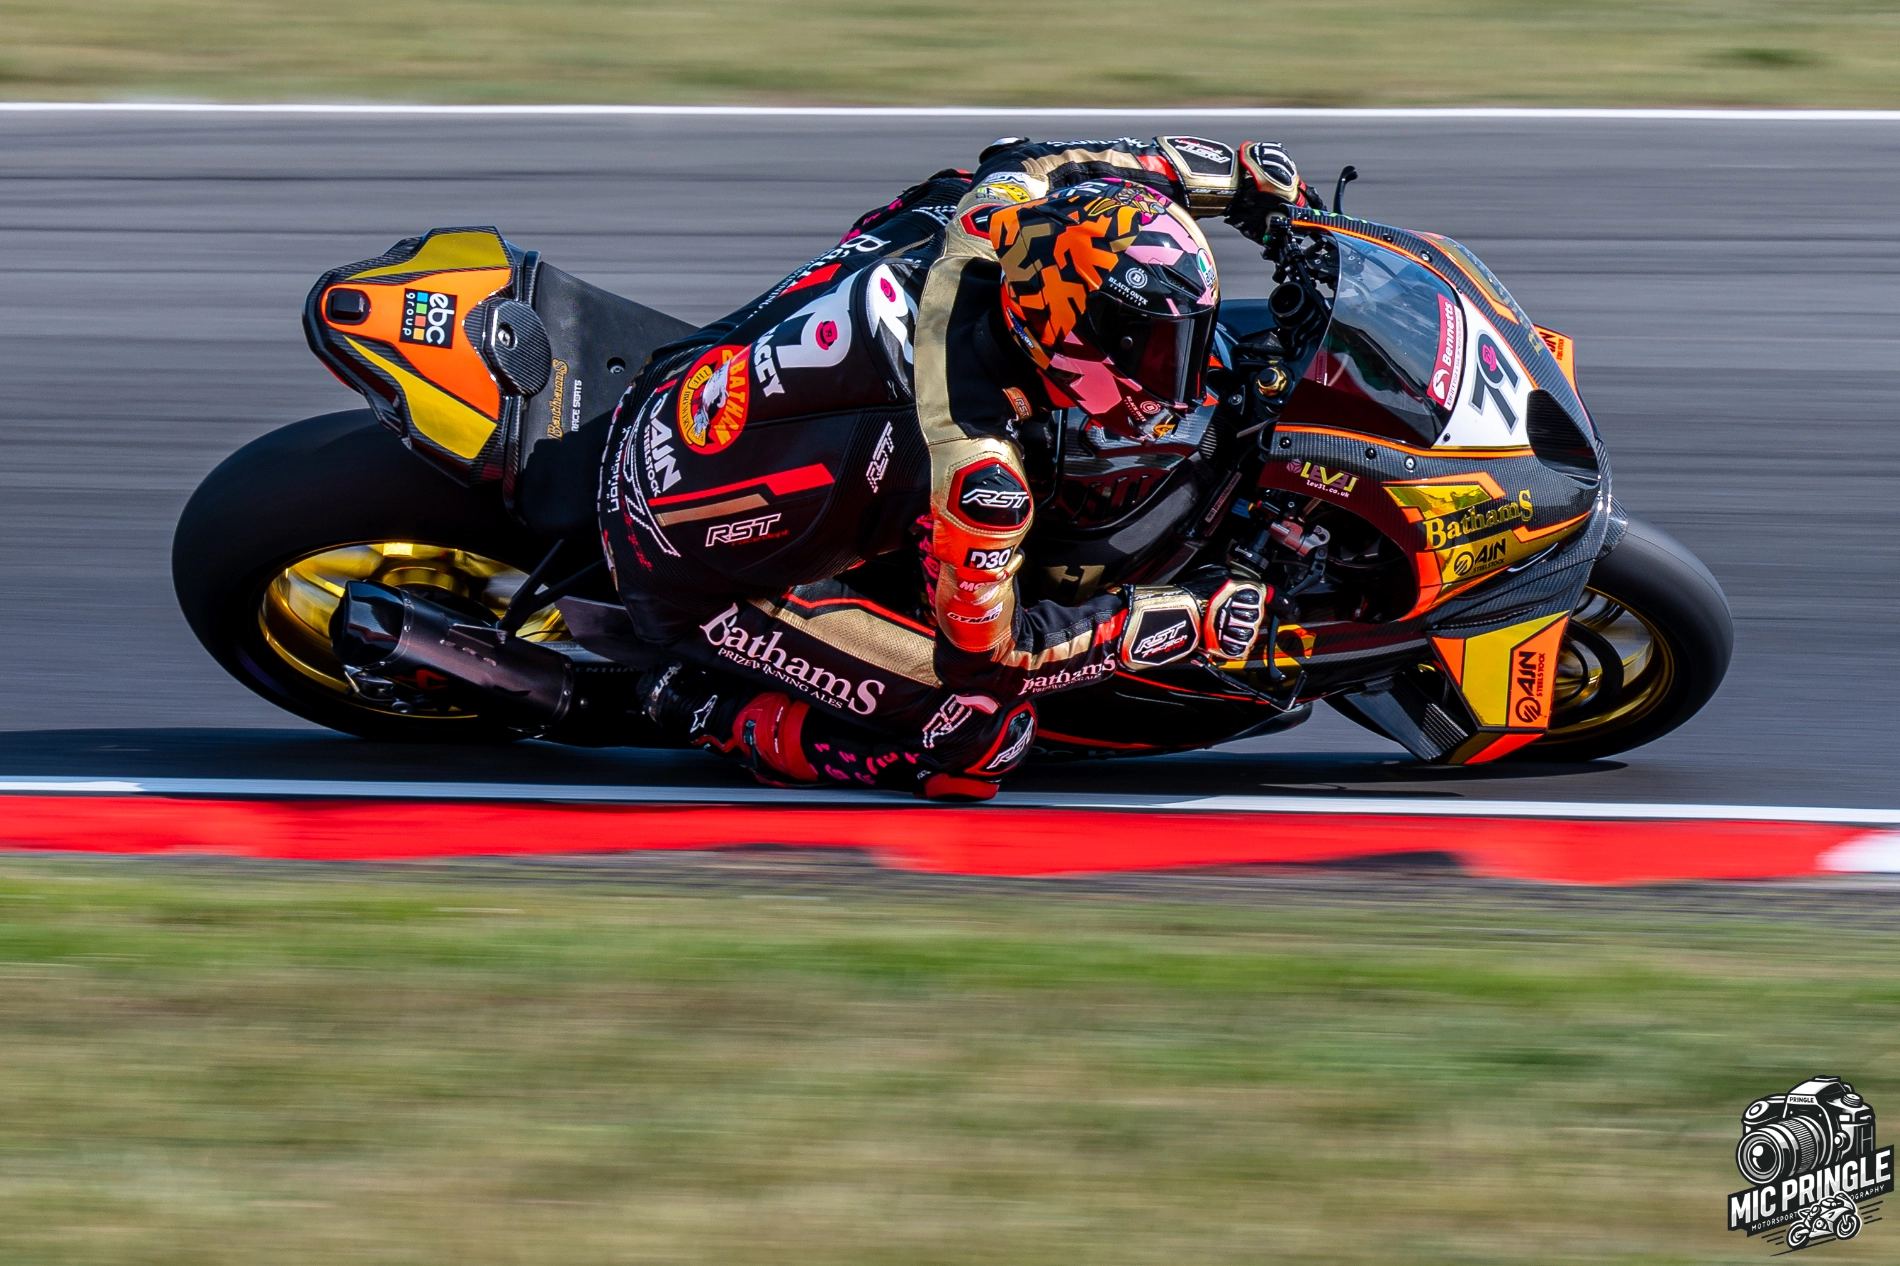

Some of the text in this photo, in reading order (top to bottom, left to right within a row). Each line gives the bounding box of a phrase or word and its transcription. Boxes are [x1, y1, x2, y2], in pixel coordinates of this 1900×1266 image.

[1108, 276, 1148, 305] BLACK ONYX
[402, 292, 416, 336] group
[426, 292, 455, 345] ebc
[1442, 301, 1455, 367] Bennetts
[571, 408, 581, 432] RACE
[1014, 397, 1029, 417] RST
[644, 424, 661, 498] STEELSTOCK
[650, 418, 682, 492] AJN
[866, 421, 895, 493] RST
[962, 489, 1029, 509] RST
[705, 513, 782, 548] RST
[1474, 538, 1506, 565] AJN
[1473, 558, 1505, 573] STEELSTOCK
[1134, 620, 1187, 654] RST
[718, 648, 809, 692] PRIZEWINNING
[811, 690, 843, 709] ALES
[1517, 651, 1537, 697] AJN
[1536, 652, 1546, 697] STEELSTOCK
